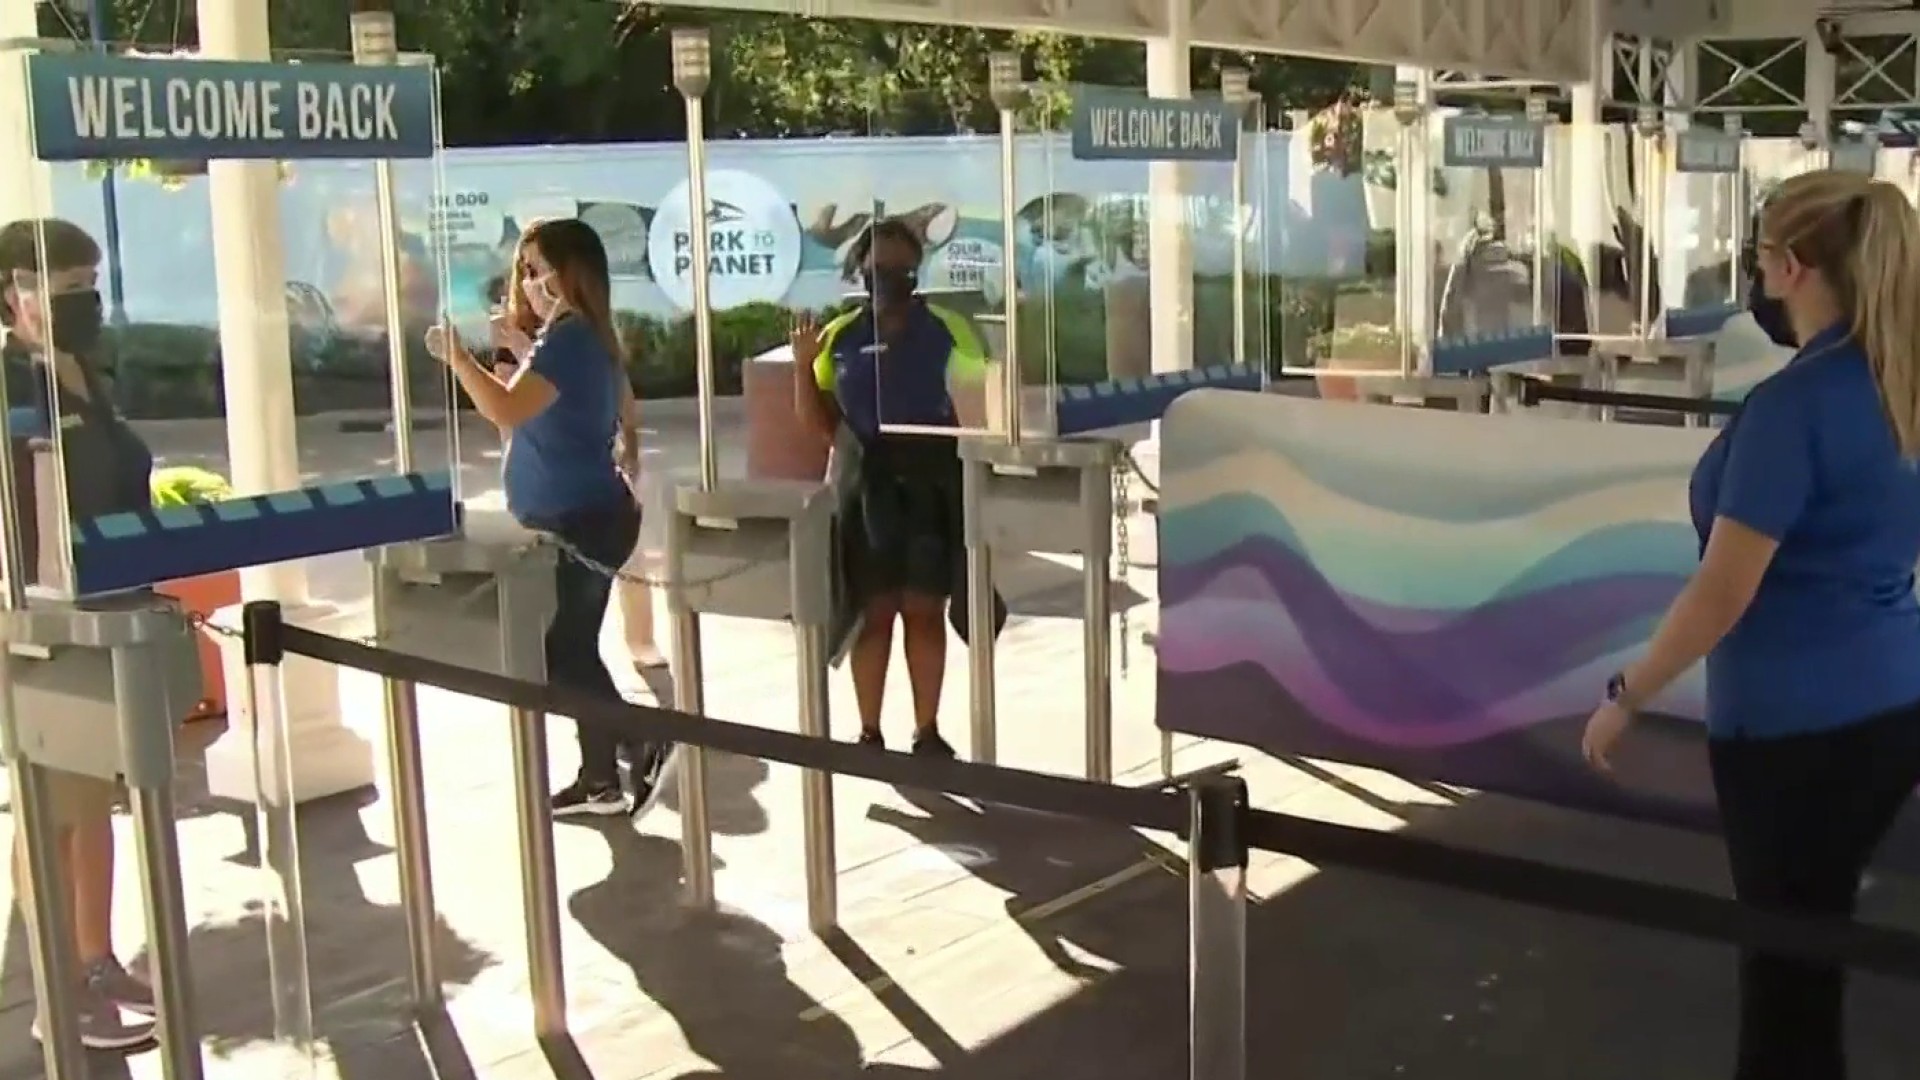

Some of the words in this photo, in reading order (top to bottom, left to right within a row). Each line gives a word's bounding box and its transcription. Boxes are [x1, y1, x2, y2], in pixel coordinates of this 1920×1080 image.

[68, 75, 283, 141] WELCOME
[297, 81, 399, 141] BACK
[1089, 106, 1175, 149] WELCOME
[1180, 110, 1223, 150] BACK
[674, 230, 745, 253] PRK
[674, 253, 776, 276] PANET
